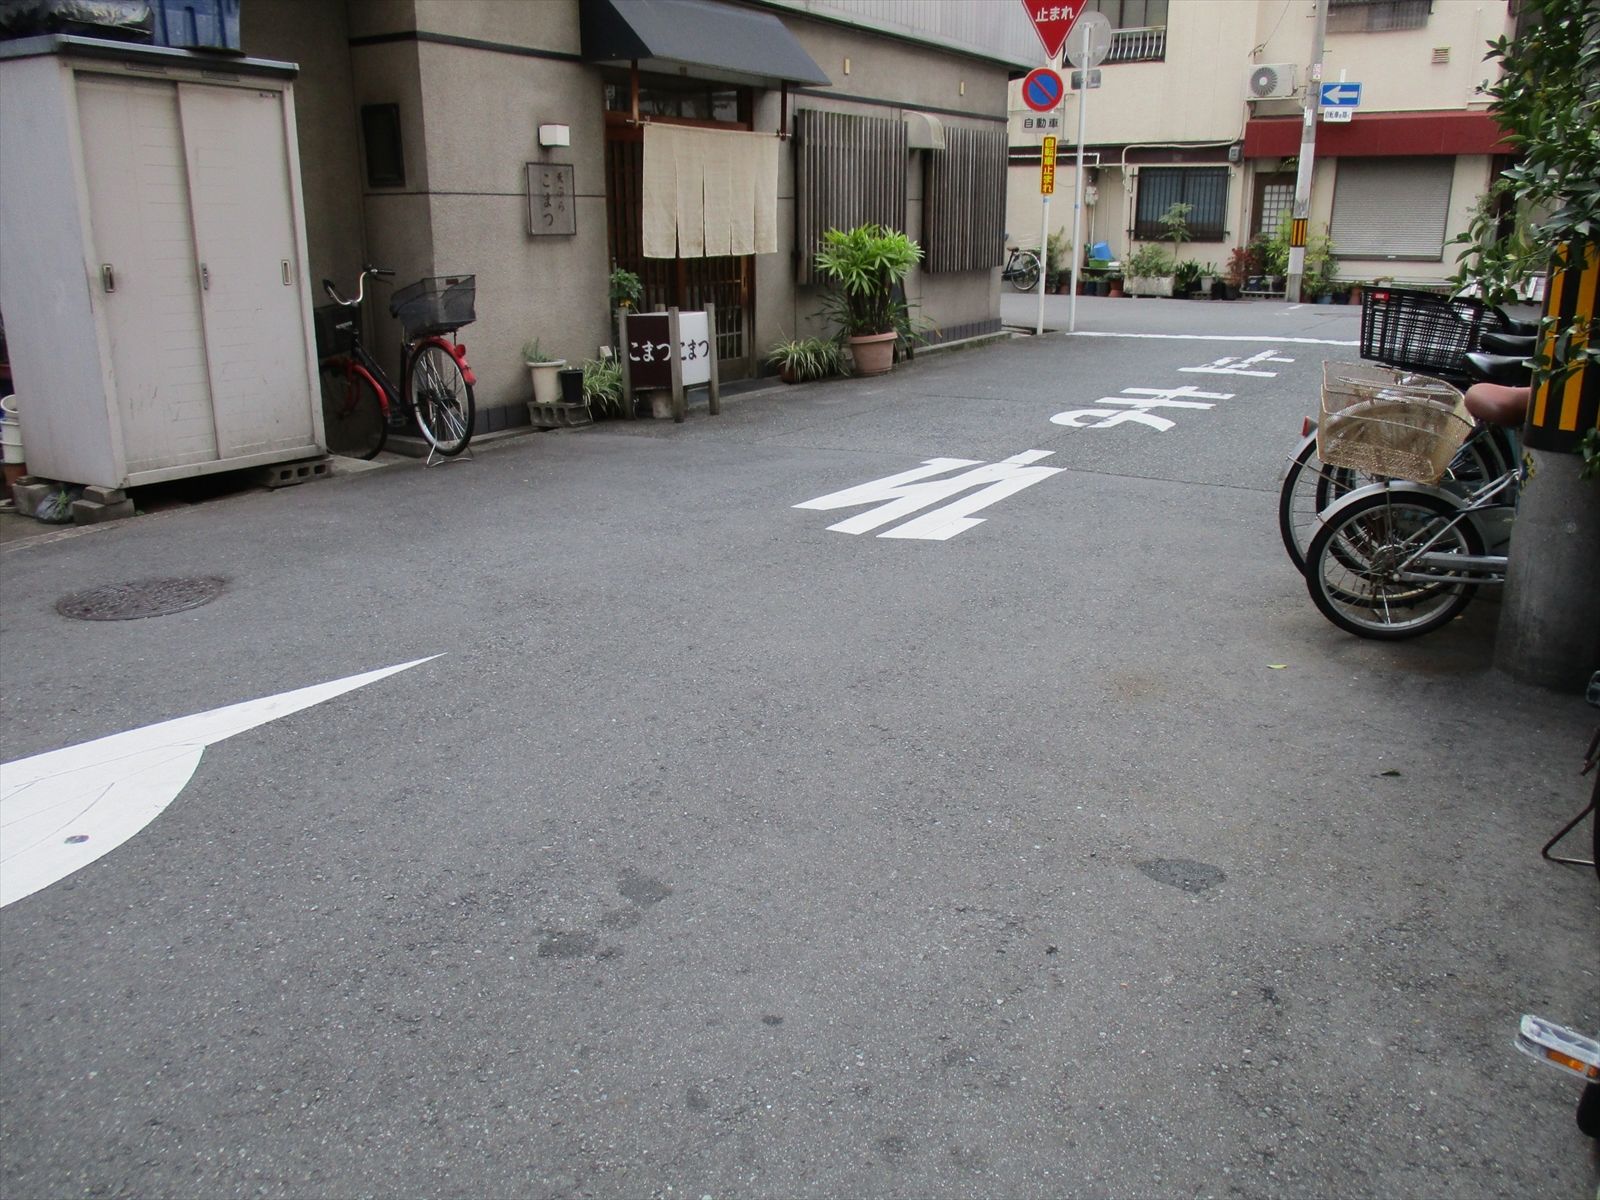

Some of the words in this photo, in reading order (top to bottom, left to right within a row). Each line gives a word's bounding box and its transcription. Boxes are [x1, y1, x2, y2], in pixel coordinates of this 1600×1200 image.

[1035, 5, 1075, 22] 止まれ
[1024, 118, 1059, 129] 自動車
[1042, 138, 1055, 193] 自転車止まれ
[542, 172, 554, 227] こまつ
[629, 340, 671, 362] こまつ
